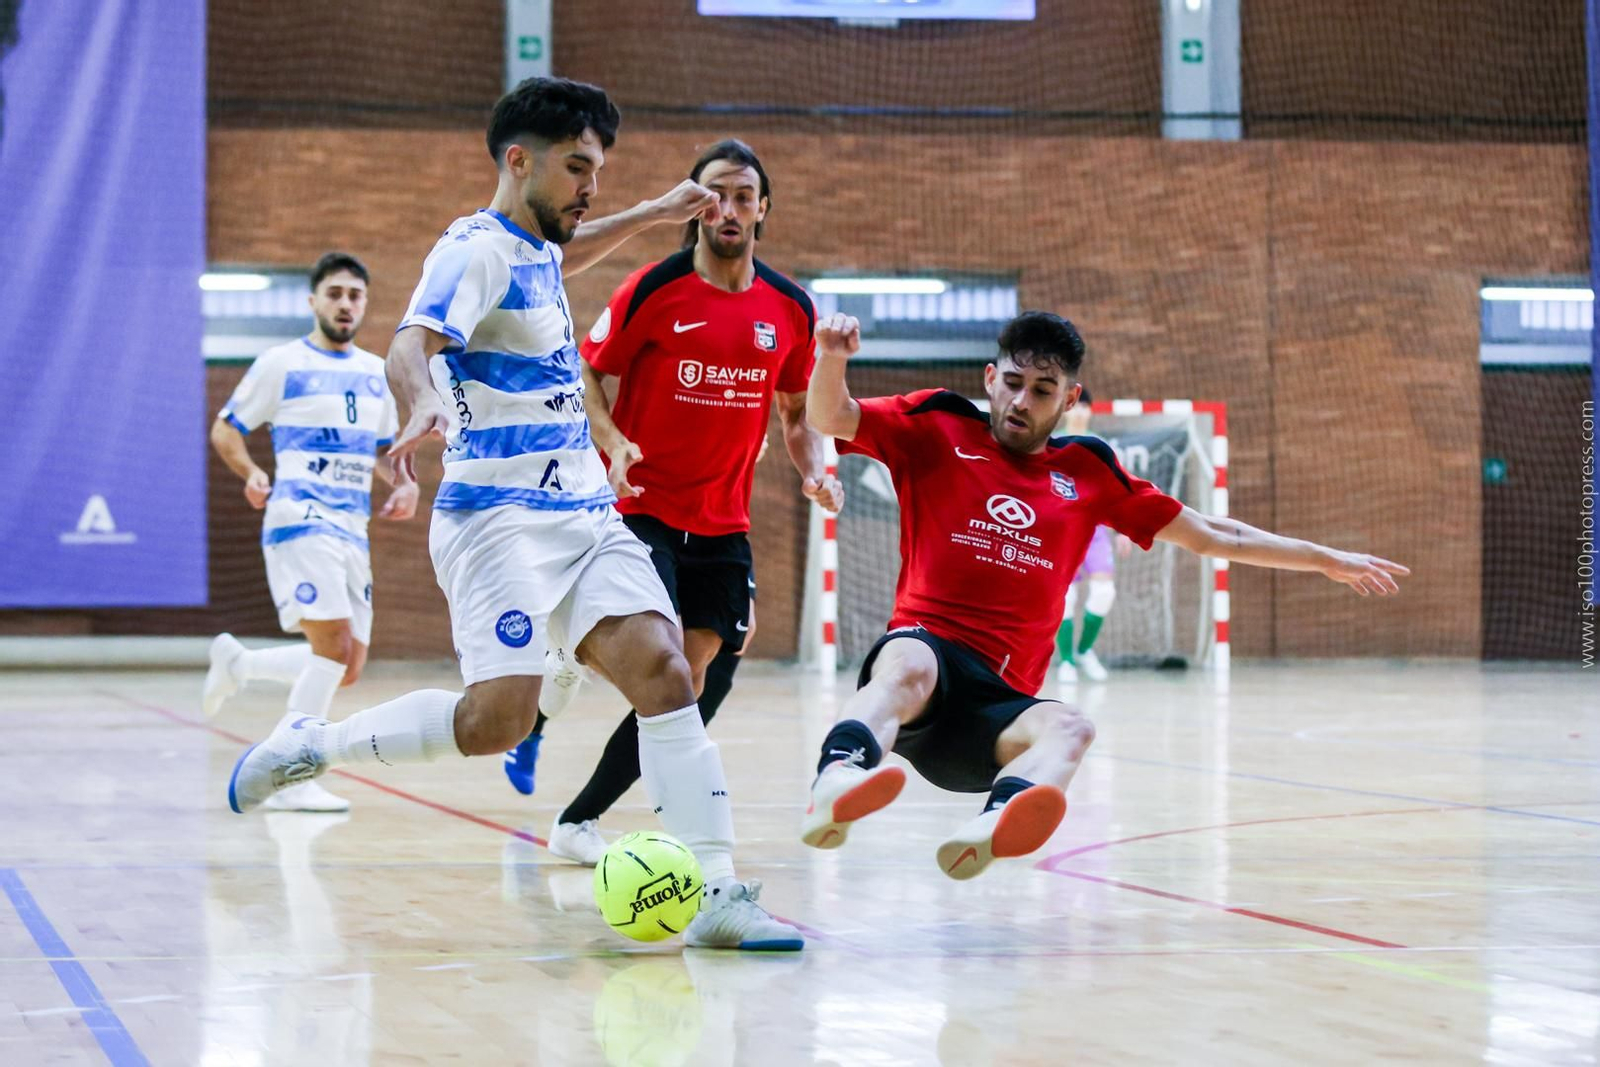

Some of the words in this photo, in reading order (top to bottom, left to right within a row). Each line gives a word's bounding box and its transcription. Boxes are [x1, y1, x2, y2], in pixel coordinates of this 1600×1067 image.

[705, 365, 768, 382] SAVHER
[345, 390, 357, 424] 8
[1017, 550, 1054, 570] SAVHER
